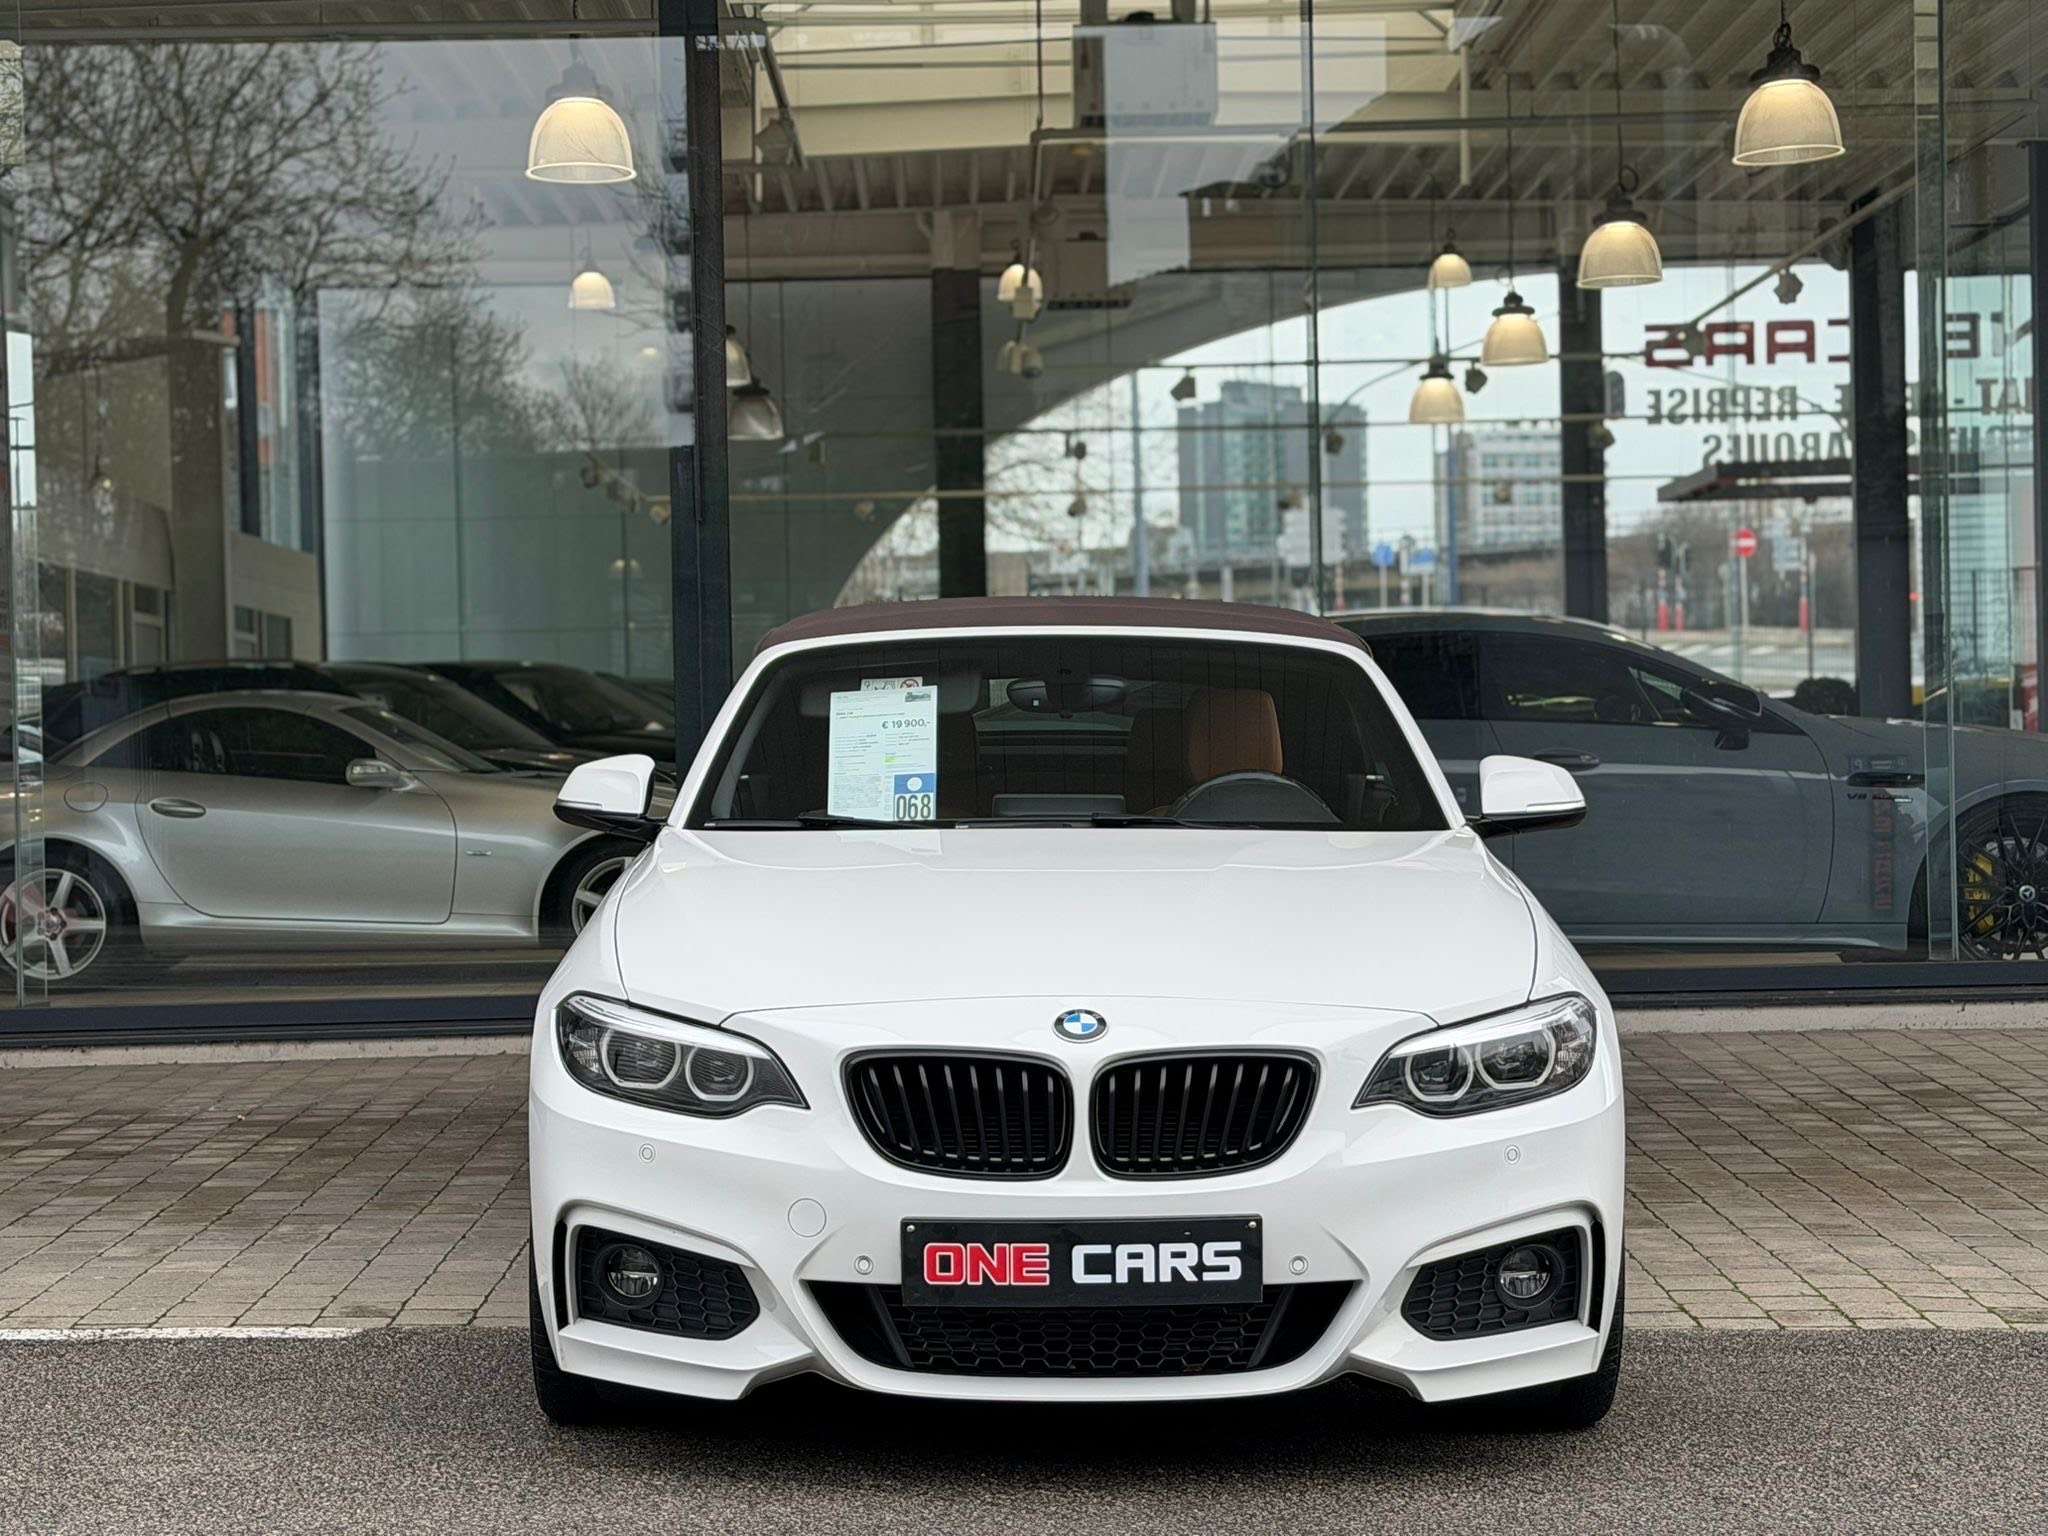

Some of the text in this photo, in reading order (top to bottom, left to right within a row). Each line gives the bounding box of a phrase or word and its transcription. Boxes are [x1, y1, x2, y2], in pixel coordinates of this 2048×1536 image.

[896, 794, 931, 820] 068
[923, 1241, 1242, 1286] ONE CARS
